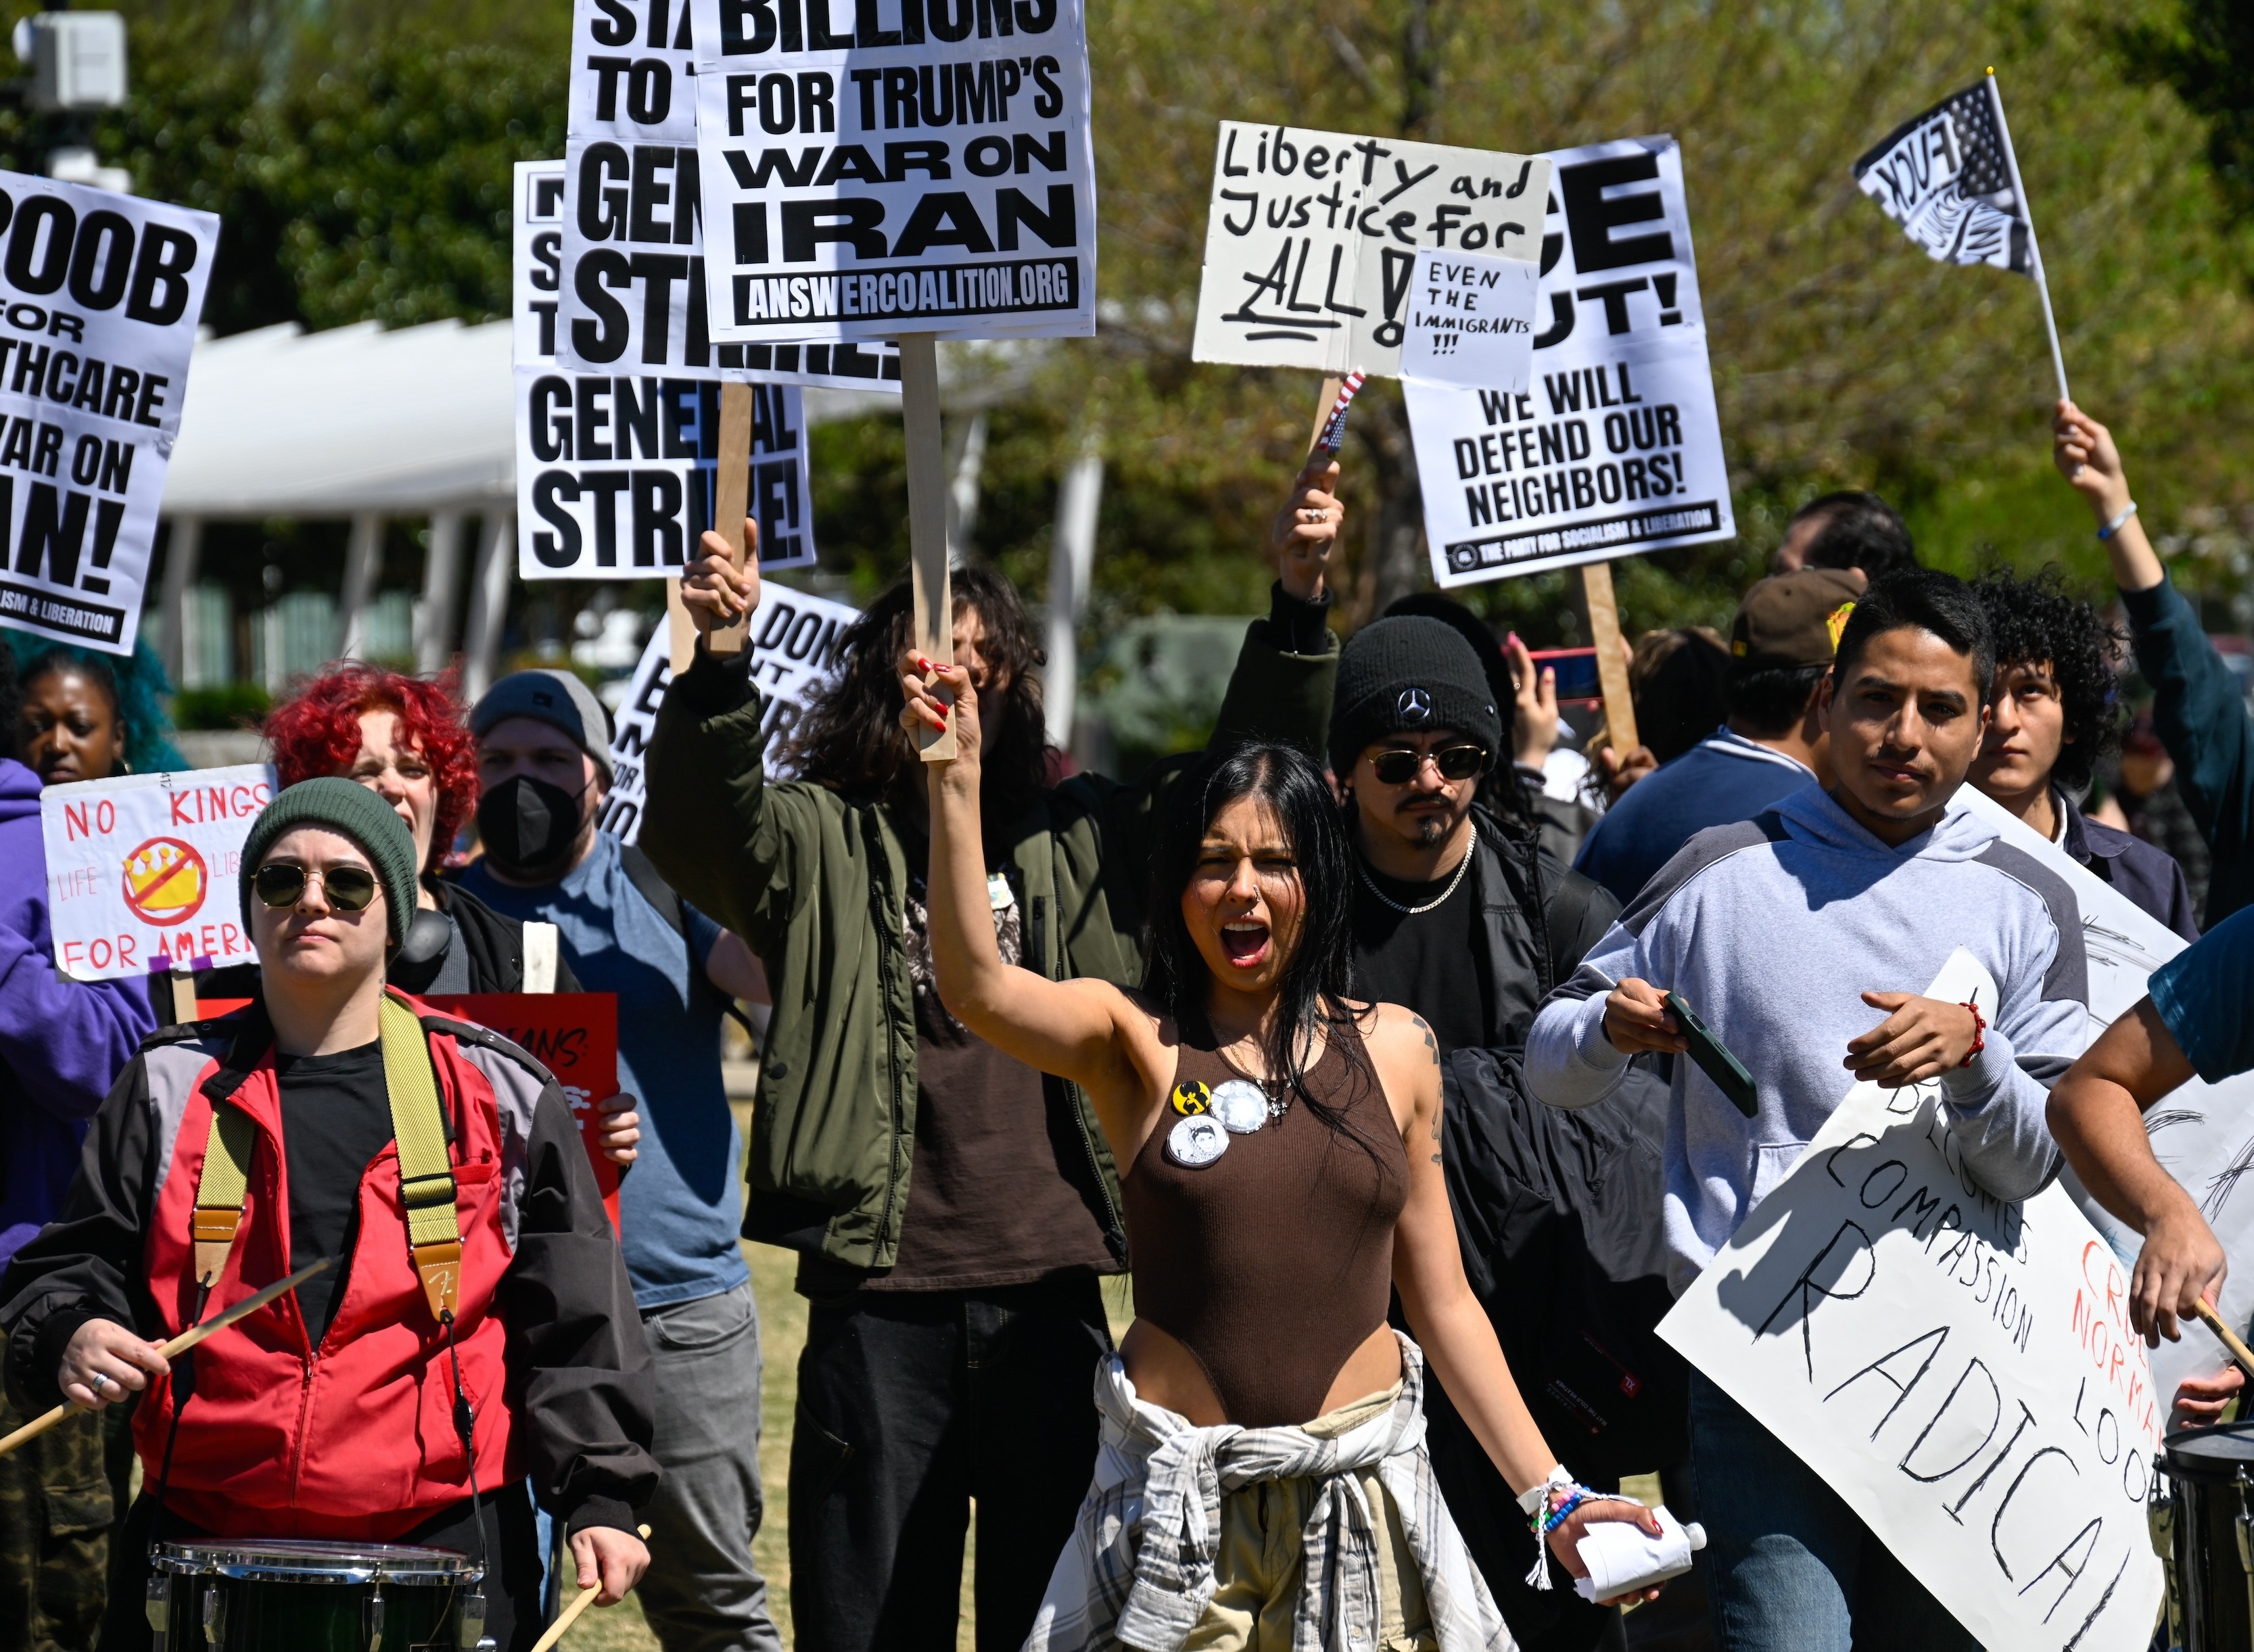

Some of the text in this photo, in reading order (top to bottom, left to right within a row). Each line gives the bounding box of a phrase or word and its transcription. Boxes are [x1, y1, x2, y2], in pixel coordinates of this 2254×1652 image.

[720, 0, 1057, 55] BILLIONS
[587, 55, 672, 124] TO
[727, 55, 1063, 137] FOR TRUMP'S
[723, 131, 1067, 189] WAR ON
[1223, 126, 1532, 205] Liberty and
[732, 184, 1077, 264] IRAN
[1220, 180, 1417, 245] Justice
[748, 263, 1069, 319] ANSWERCOALITION.ORG
[1428, 287, 1478, 310] THE
[1430, 262, 1501, 289] EVEN
[0, 298, 85, 344] OR
[1415, 311, 1530, 333] IMMIGRANTS
[1479, 361, 1642, 425] WE WILL
[0, 413, 135, 495] AR ON
[1454, 403, 1683, 479] DEFEND OUR
[532, 457, 803, 567] STRIE!
[1465, 452, 1686, 527] NEIGHBORS!
[0, 475, 125, 595] N!
[1479, 543, 1503, 563] THE
[1504, 536, 1539, 559] PARTY
[1539, 532, 1562, 554] FOR
[1562, 520, 1630, 548] SOCIALISM
[1632, 519, 1642, 536] &
[1643, 509, 1712, 534] LIBERATION
[29, 597, 39, 617] &
[41, 600, 114, 635] LIBERATION
[64, 783, 269, 841] NO KINGS
[57, 866, 97, 901] LIFE
[63, 934, 137, 972] FOR
[1827, 1133, 2033, 1353] COMPASSION
